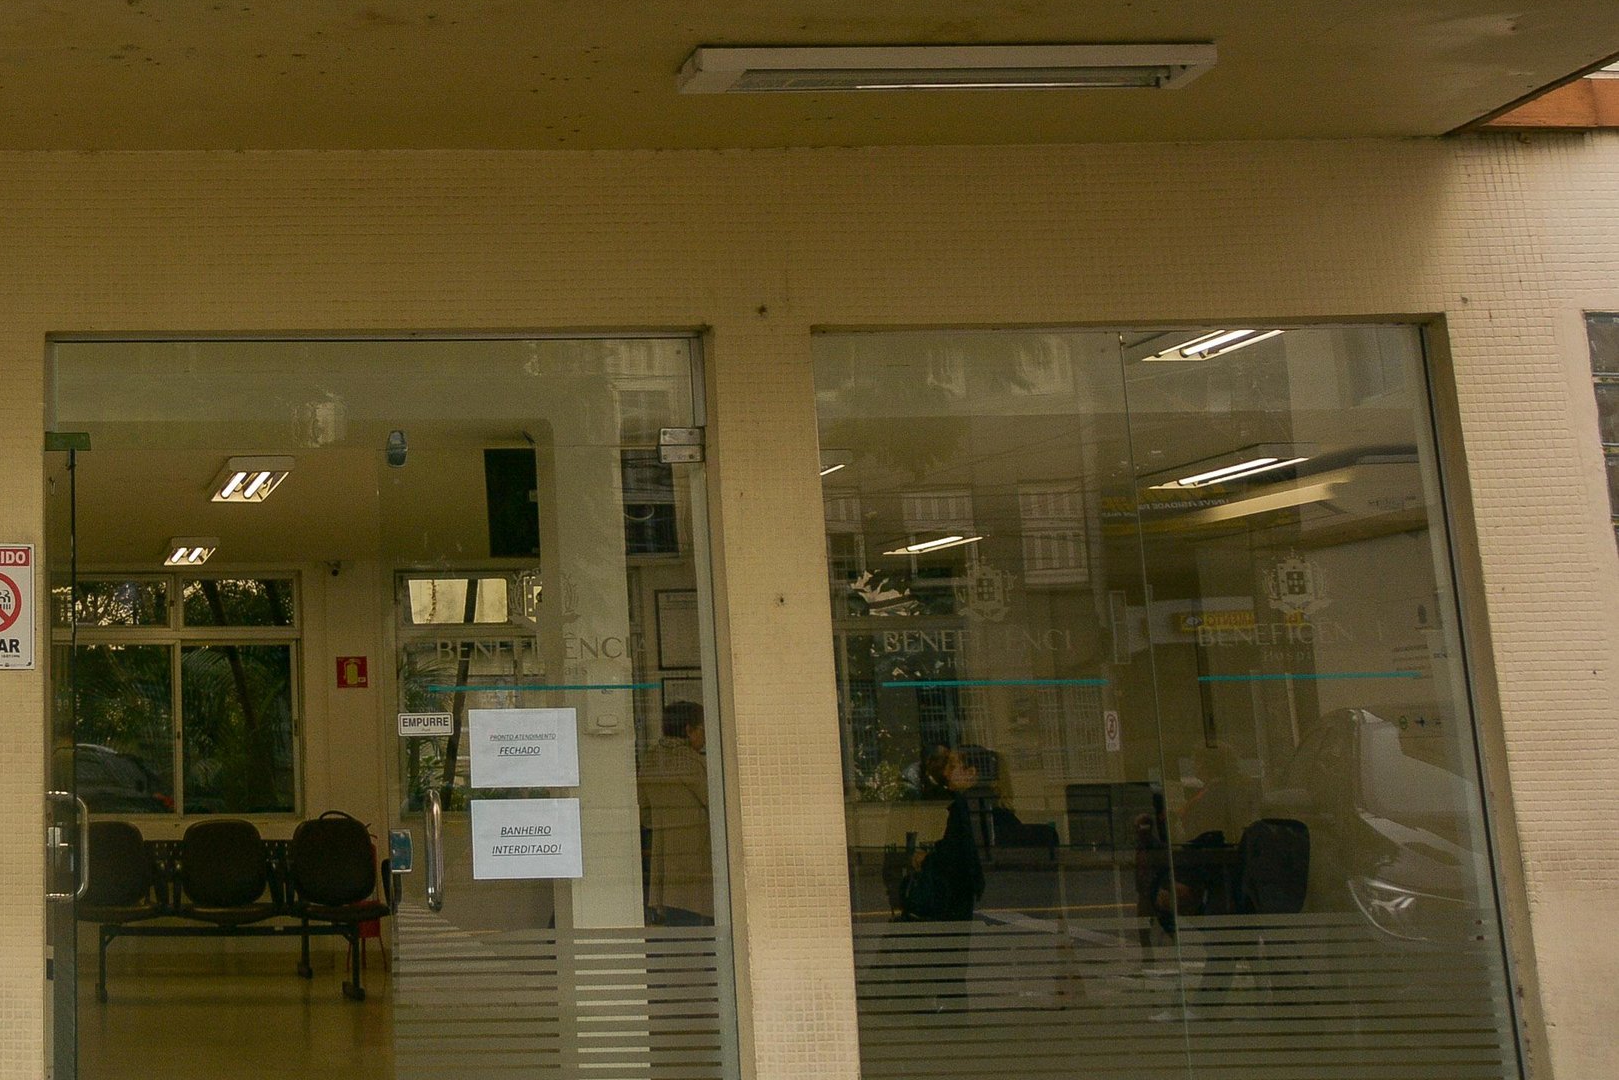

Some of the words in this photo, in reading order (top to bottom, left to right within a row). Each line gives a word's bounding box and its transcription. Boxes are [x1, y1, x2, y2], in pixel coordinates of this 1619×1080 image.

[402, 717, 449, 727] EMPURRE
[499, 746, 541, 755] FECHADO
[500, 826, 551, 836] BANHEIRO
[492, 843, 562, 854] INTERDITADO!
